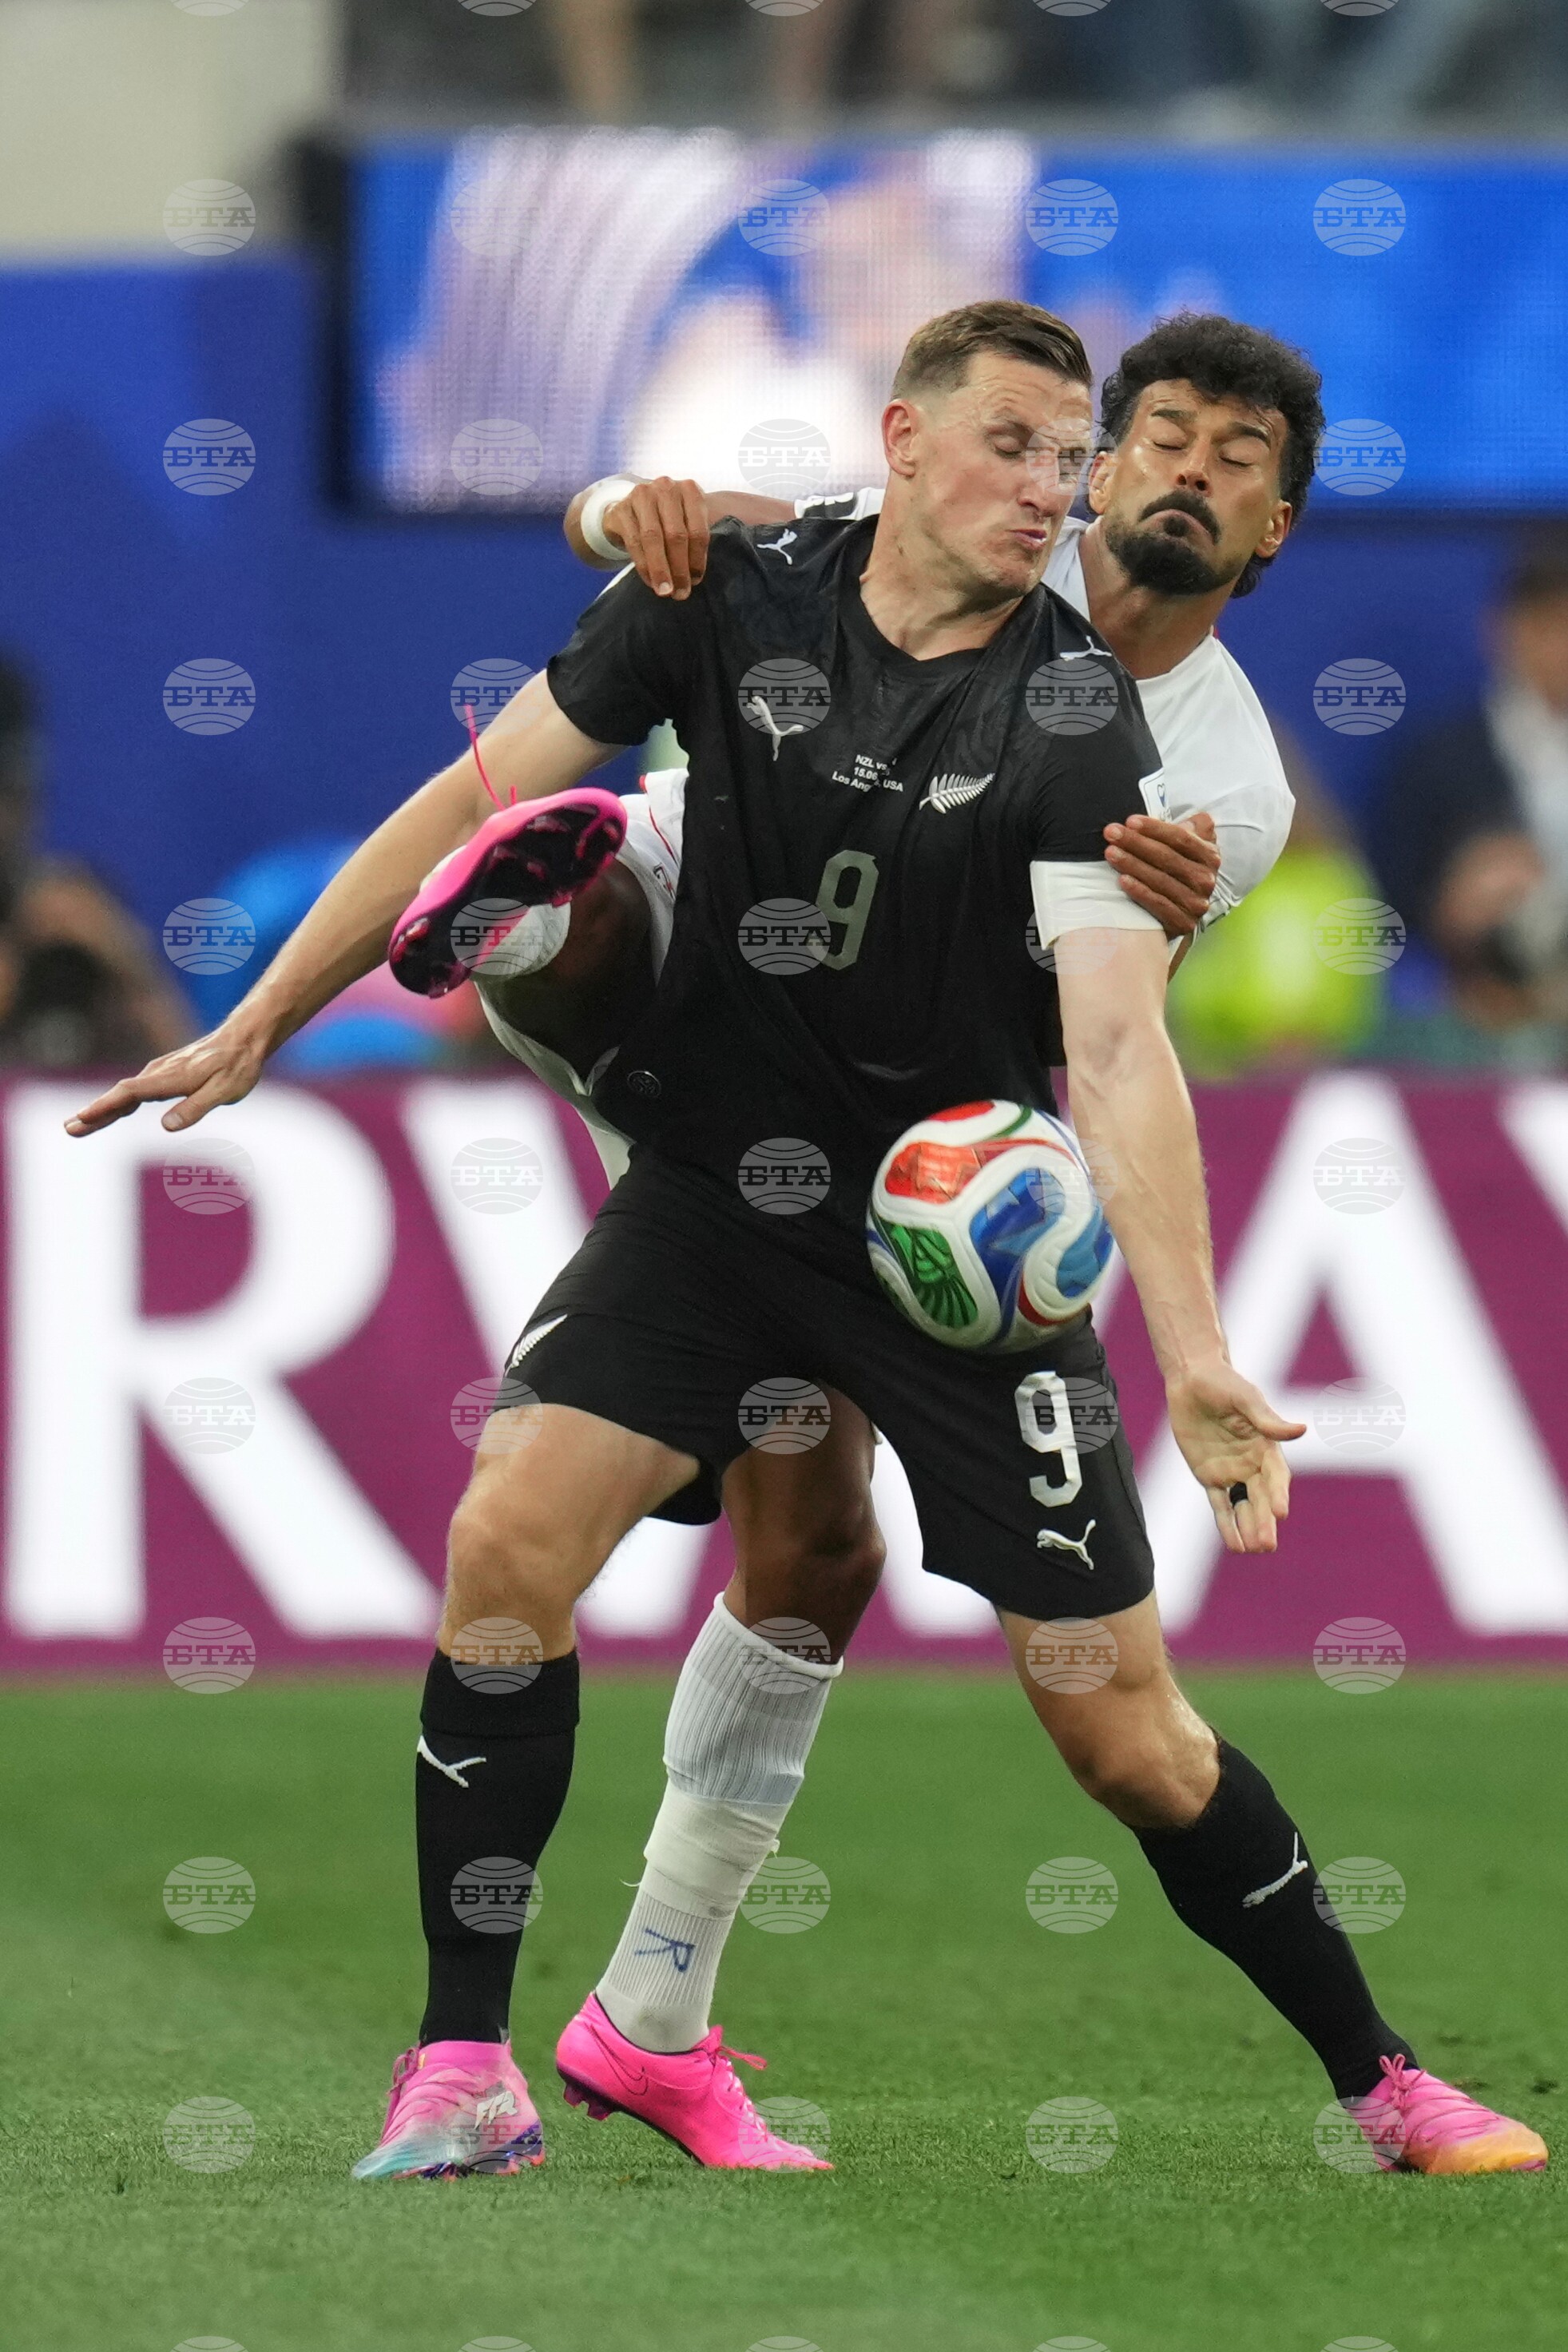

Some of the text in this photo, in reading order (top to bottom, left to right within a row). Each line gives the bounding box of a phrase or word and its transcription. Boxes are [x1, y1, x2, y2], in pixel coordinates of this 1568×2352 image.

[855, 754, 875, 769] NZL
[876, 761, 887, 770] vs
[832, 771, 903, 793] Los Ang USA
[854, 766, 890, 781] 15.06
[806, 849, 879, 971] 9
[1014, 1370, 1082, 1508] 9
